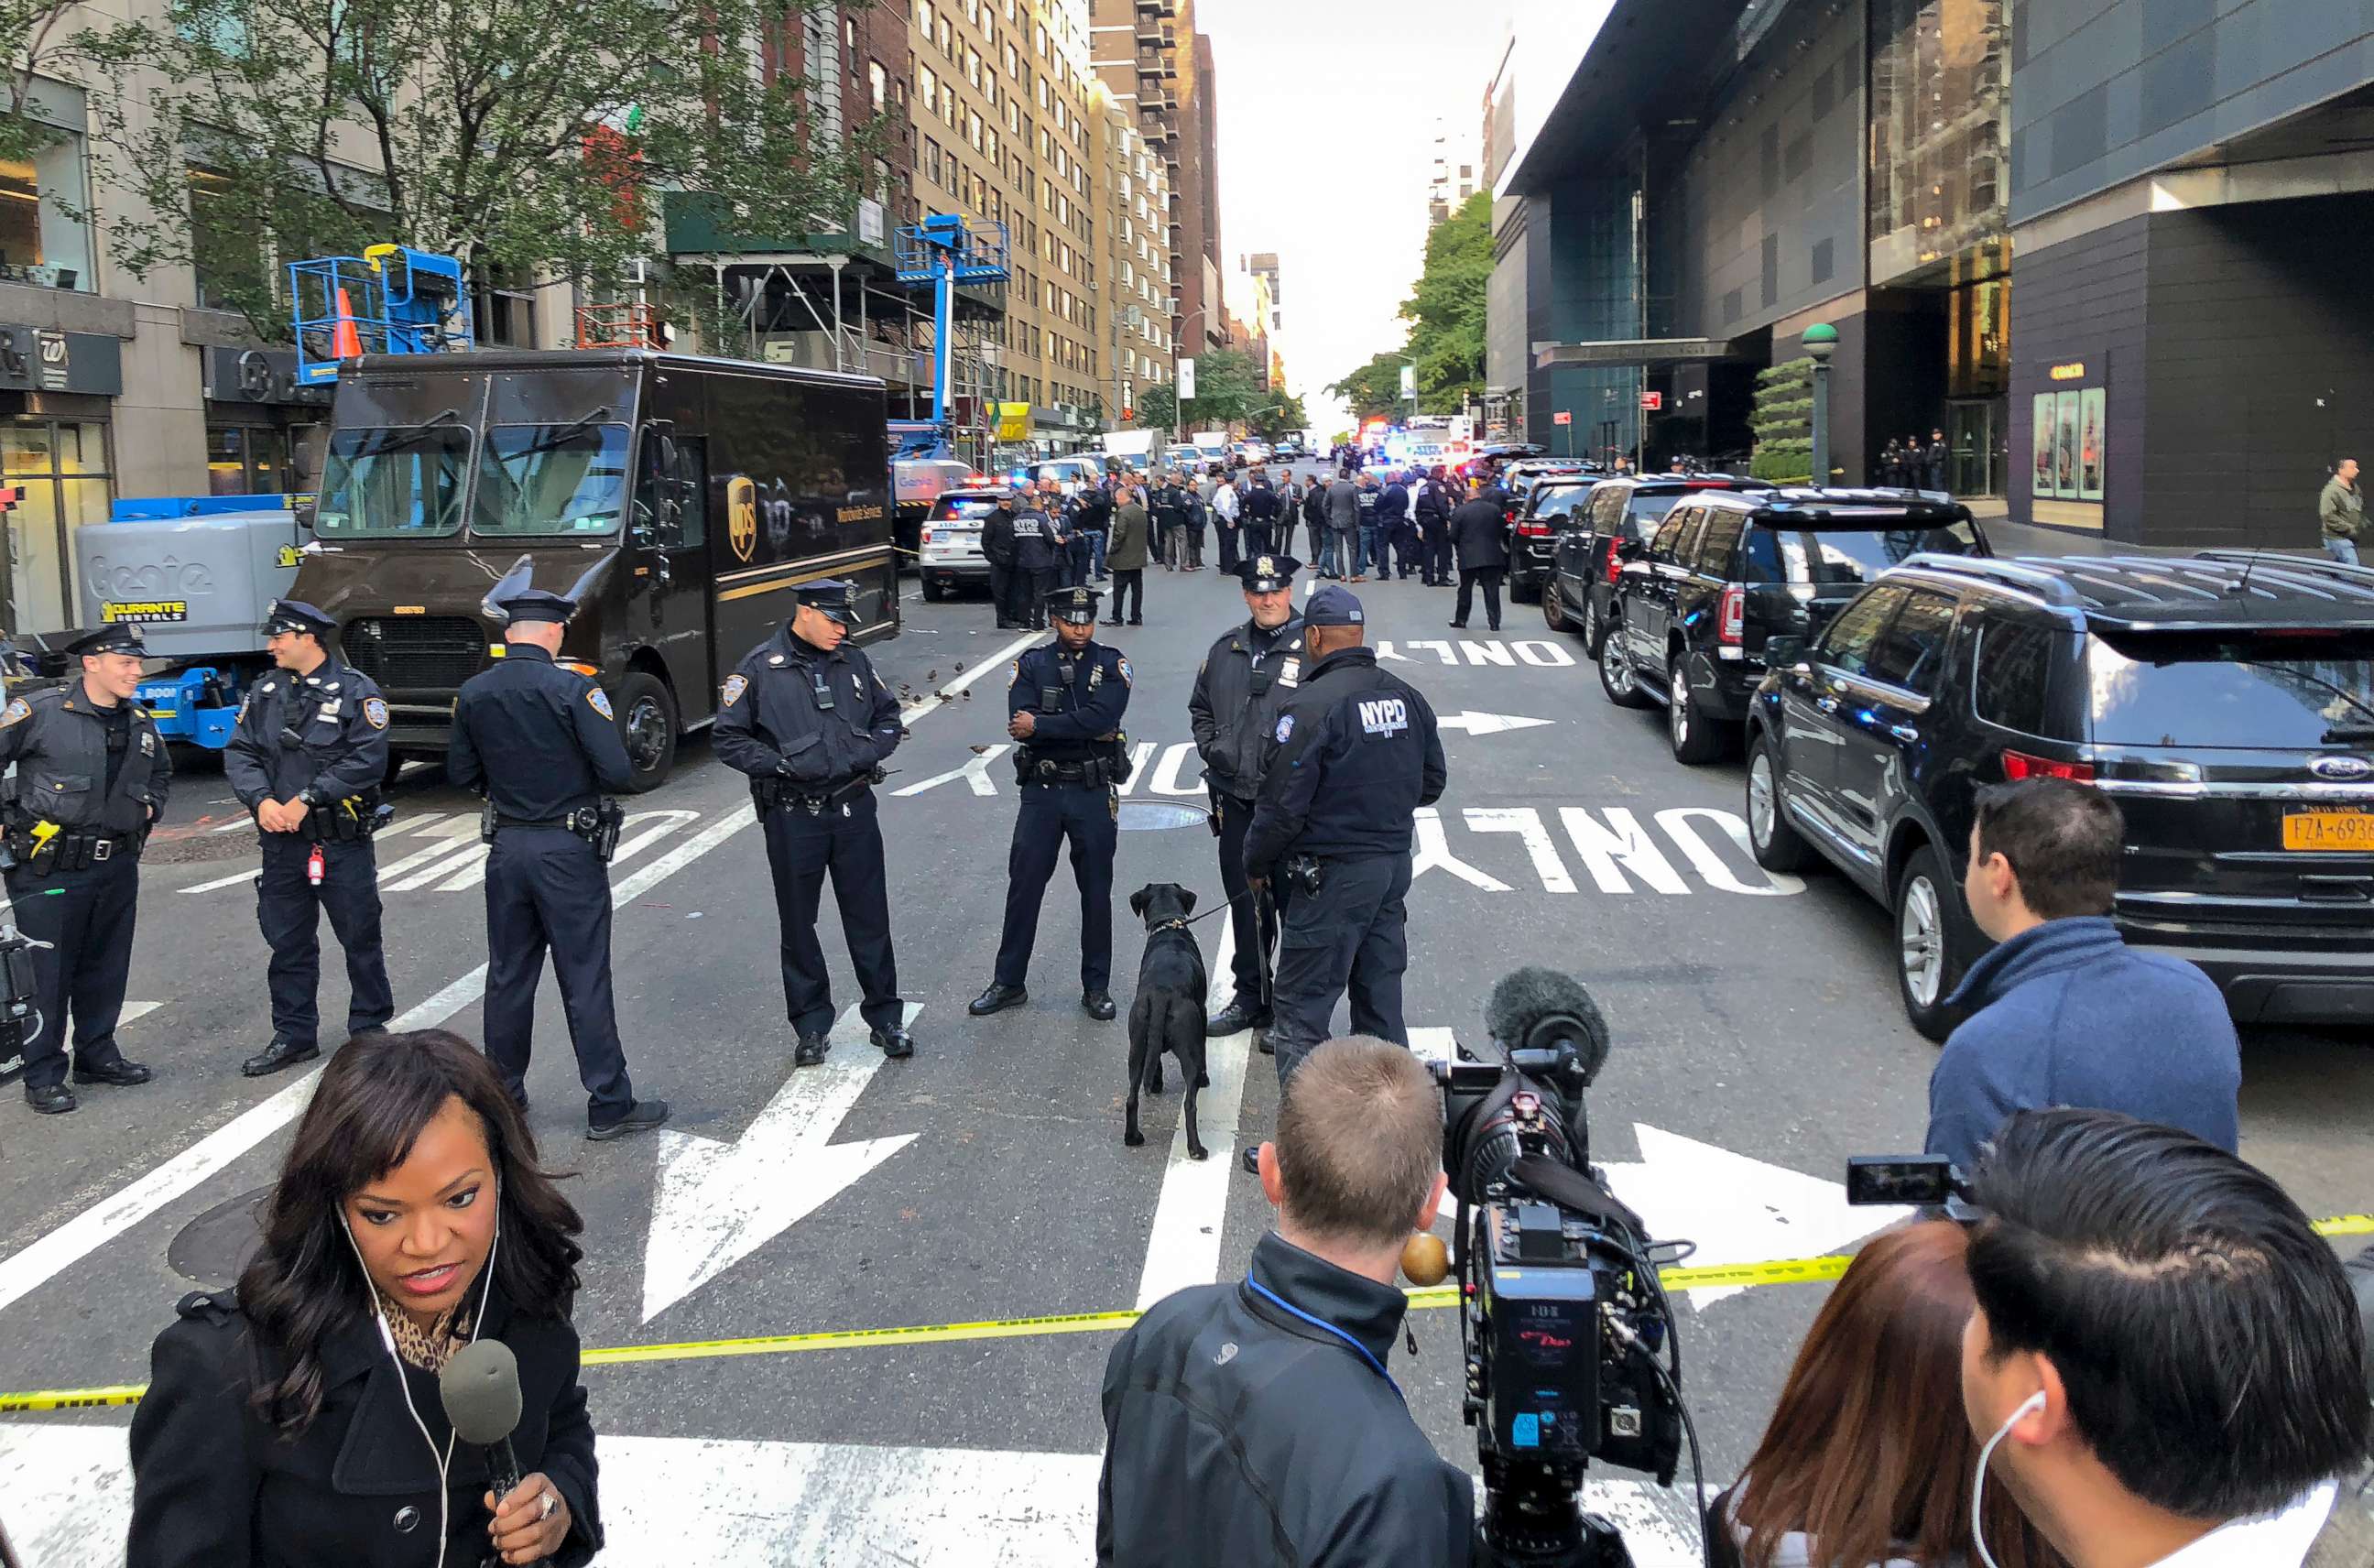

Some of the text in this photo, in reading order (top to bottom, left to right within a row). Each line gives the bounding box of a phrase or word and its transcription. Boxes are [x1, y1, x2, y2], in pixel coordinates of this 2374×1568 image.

[733, 502, 756, 550] ups
[1013, 518, 1039, 528] NYPD
[114, 602, 185, 615] DURANTE
[1375, 640, 1576, 667] ONLY
[1358, 698, 1407, 727] NYPD
[1411, 807, 1807, 896] ONLY
